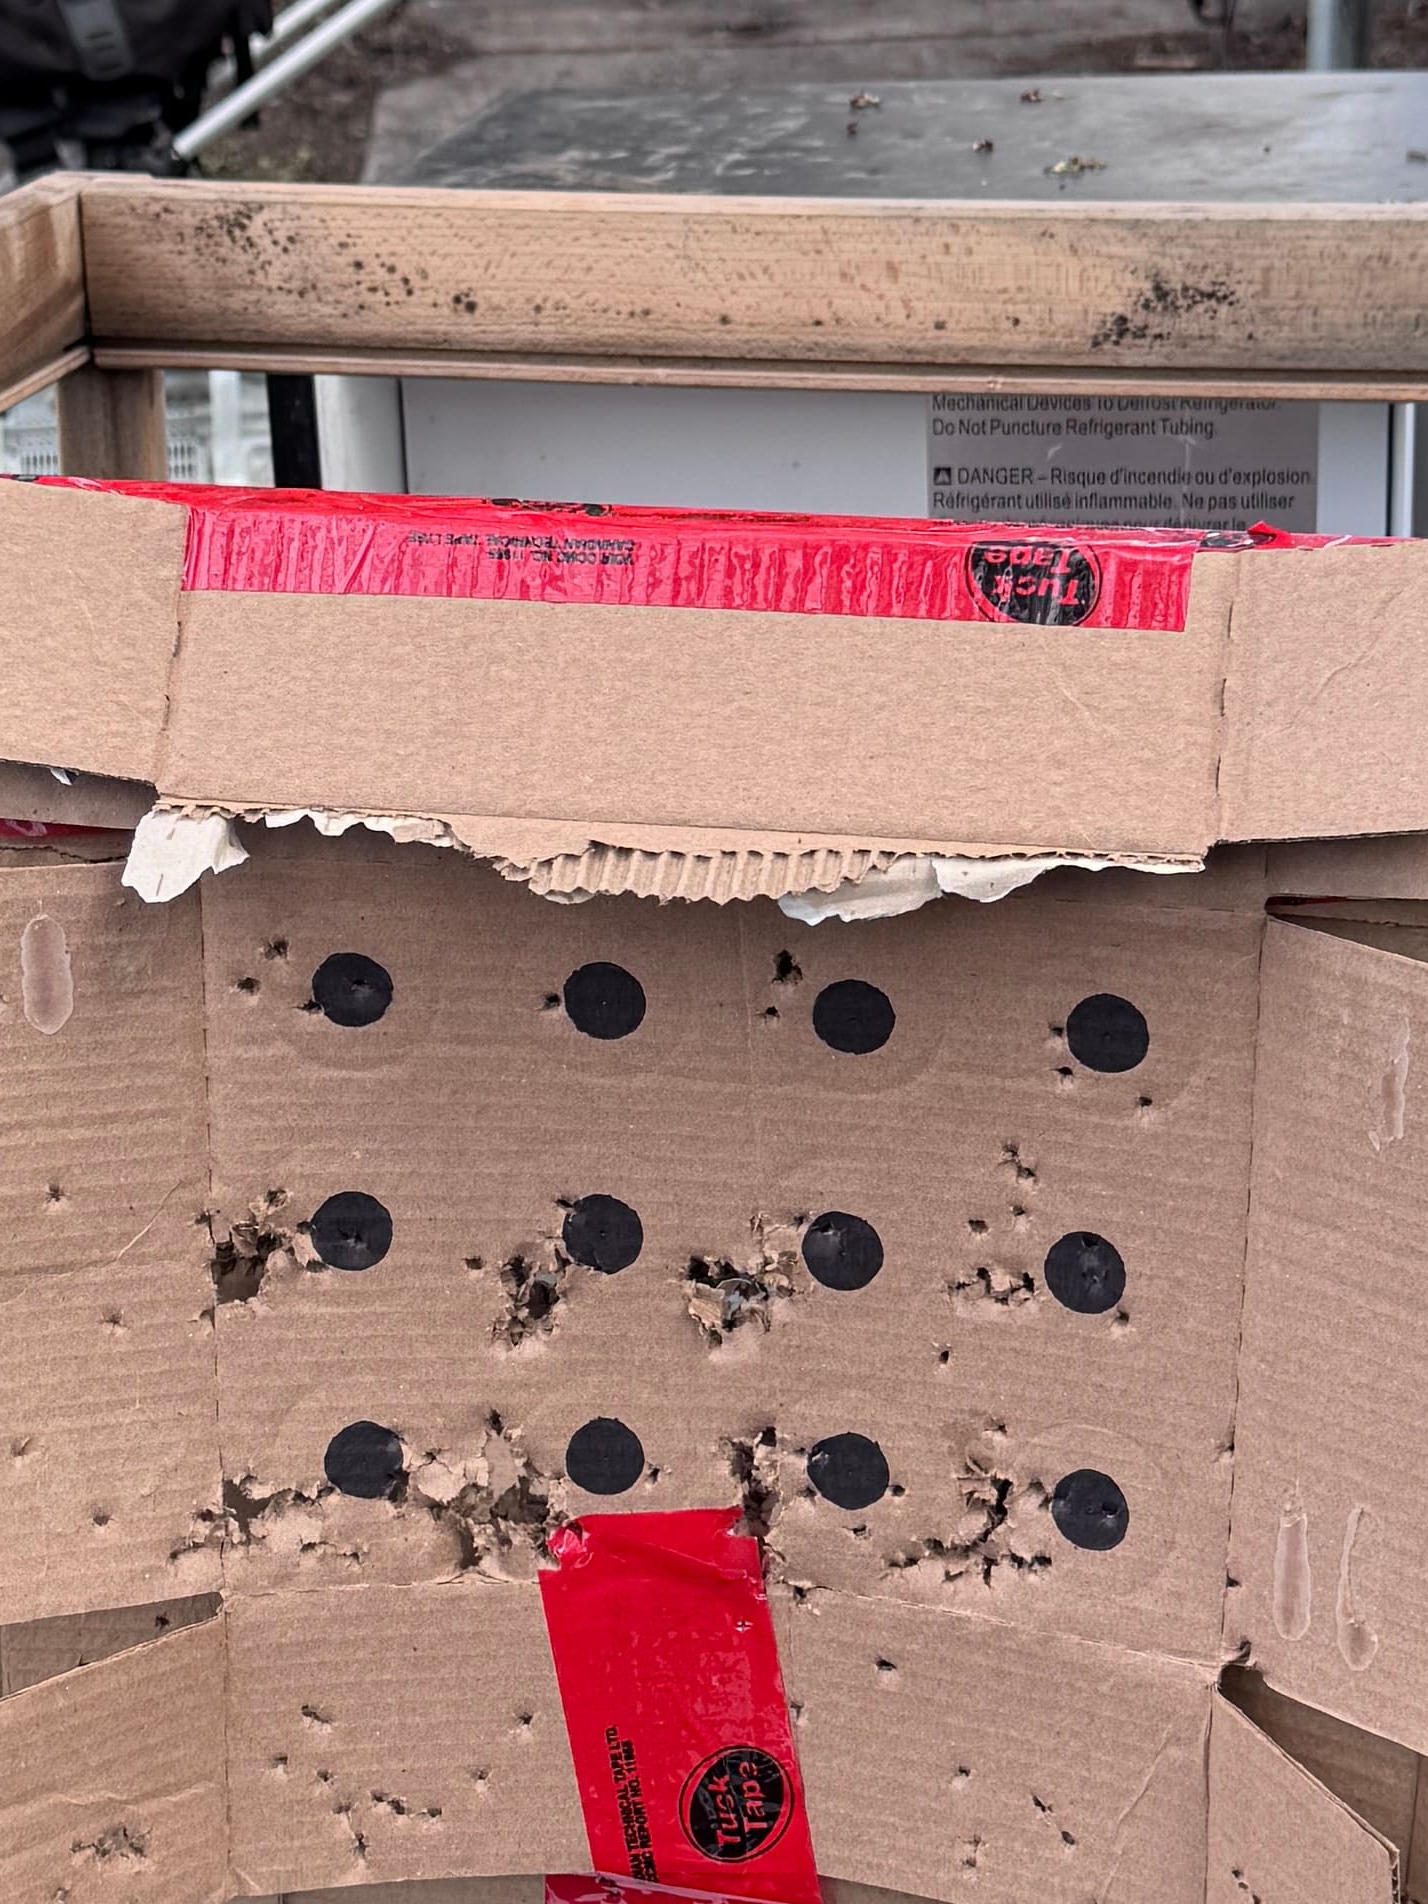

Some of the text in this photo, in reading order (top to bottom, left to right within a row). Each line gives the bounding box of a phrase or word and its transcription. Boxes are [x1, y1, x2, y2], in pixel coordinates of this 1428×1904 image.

[932, 396, 1022, 411] Mechanical
[1027, 396, 1091, 411] Devices
[932, 418, 1217, 439] Do Not Puncture Refrigerant Tubing.
[958, 467, 1310, 488] DANGER Risque d'incendie ou d'explosion
[933, 492, 1295, 513] Réfrigérant utilisé inflammable. Ne pas utiliser
[983, 547, 1069, 573] Tape
[992, 575, 1078, 605] Tuck
[605, 1726, 639, 1852] TECHNICAL TAPE LTD.
[738, 1759, 766, 1832] Tape
[628, 1775, 650, 1849] REPORT NO.
